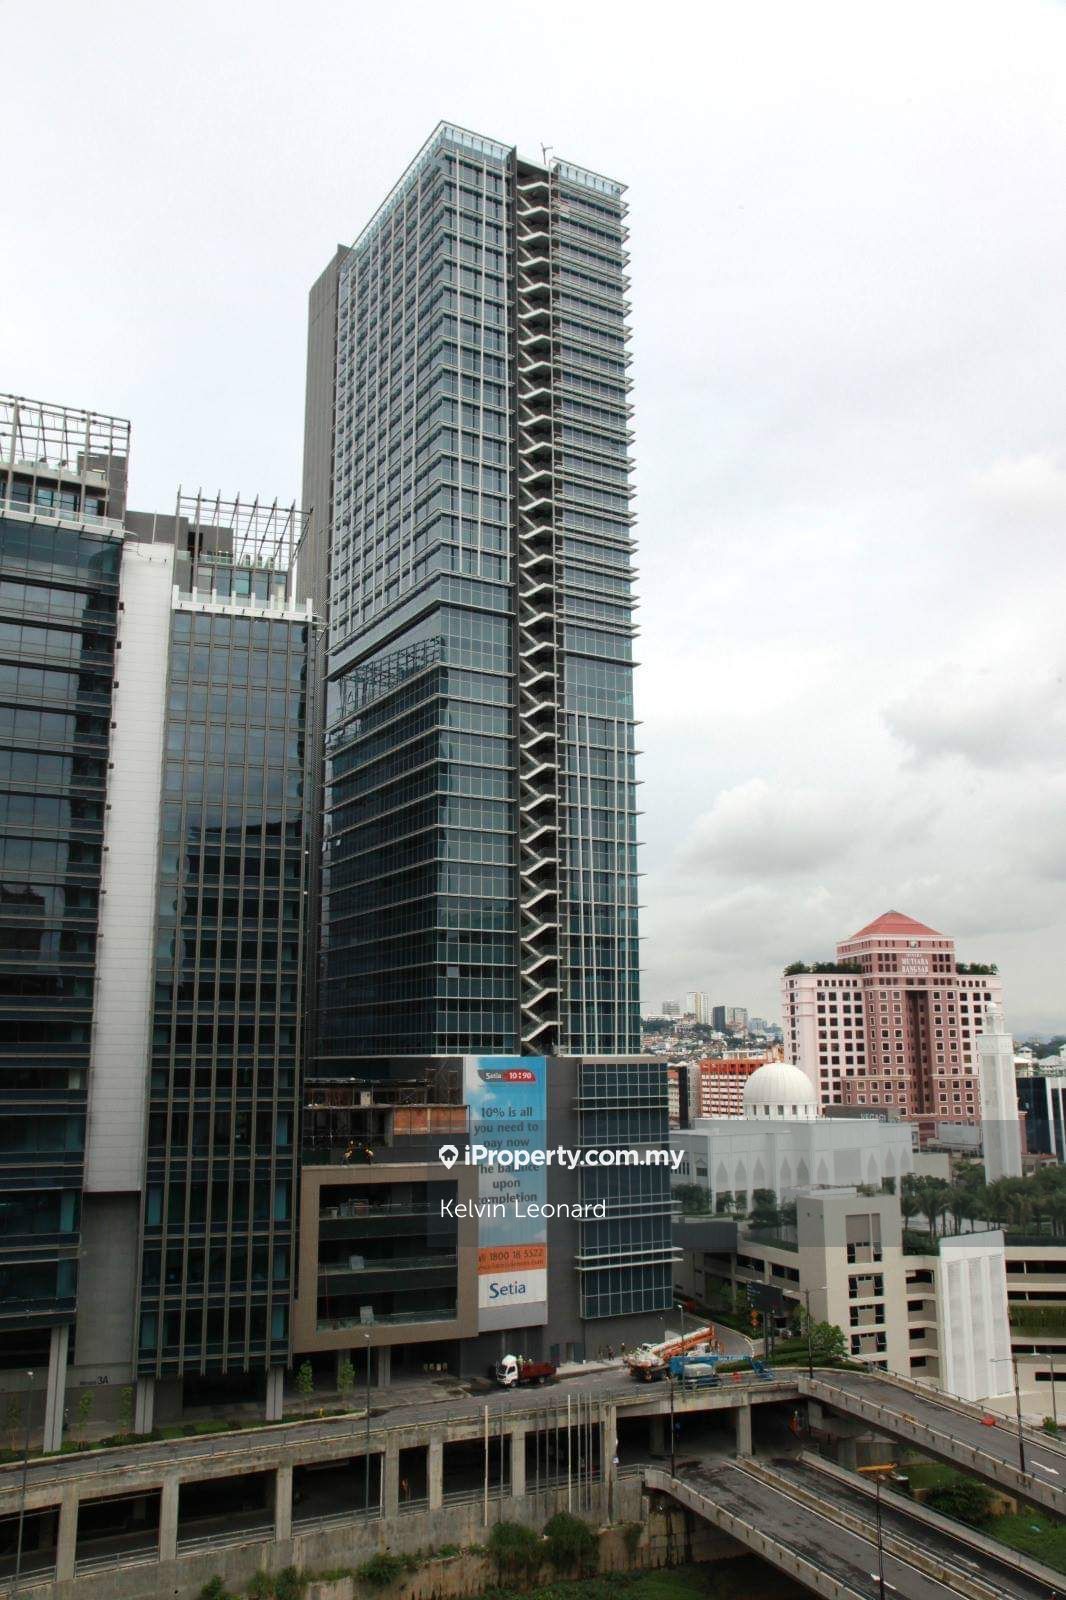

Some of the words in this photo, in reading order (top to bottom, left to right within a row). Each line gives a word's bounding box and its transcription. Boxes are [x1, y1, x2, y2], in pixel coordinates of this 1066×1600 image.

[481, 1107, 505, 1118] 10%
[508, 1106, 517, 1117] is
[520, 1106, 533, 1117] all
[473, 1123, 493, 1137] you
[497, 1121, 524, 1133] need
[527, 1121, 539, 1132] to
[506, 1138, 530, 1147] now
[492, 1180, 521, 1191] upon
[489, 1281, 526, 1299] Setia
